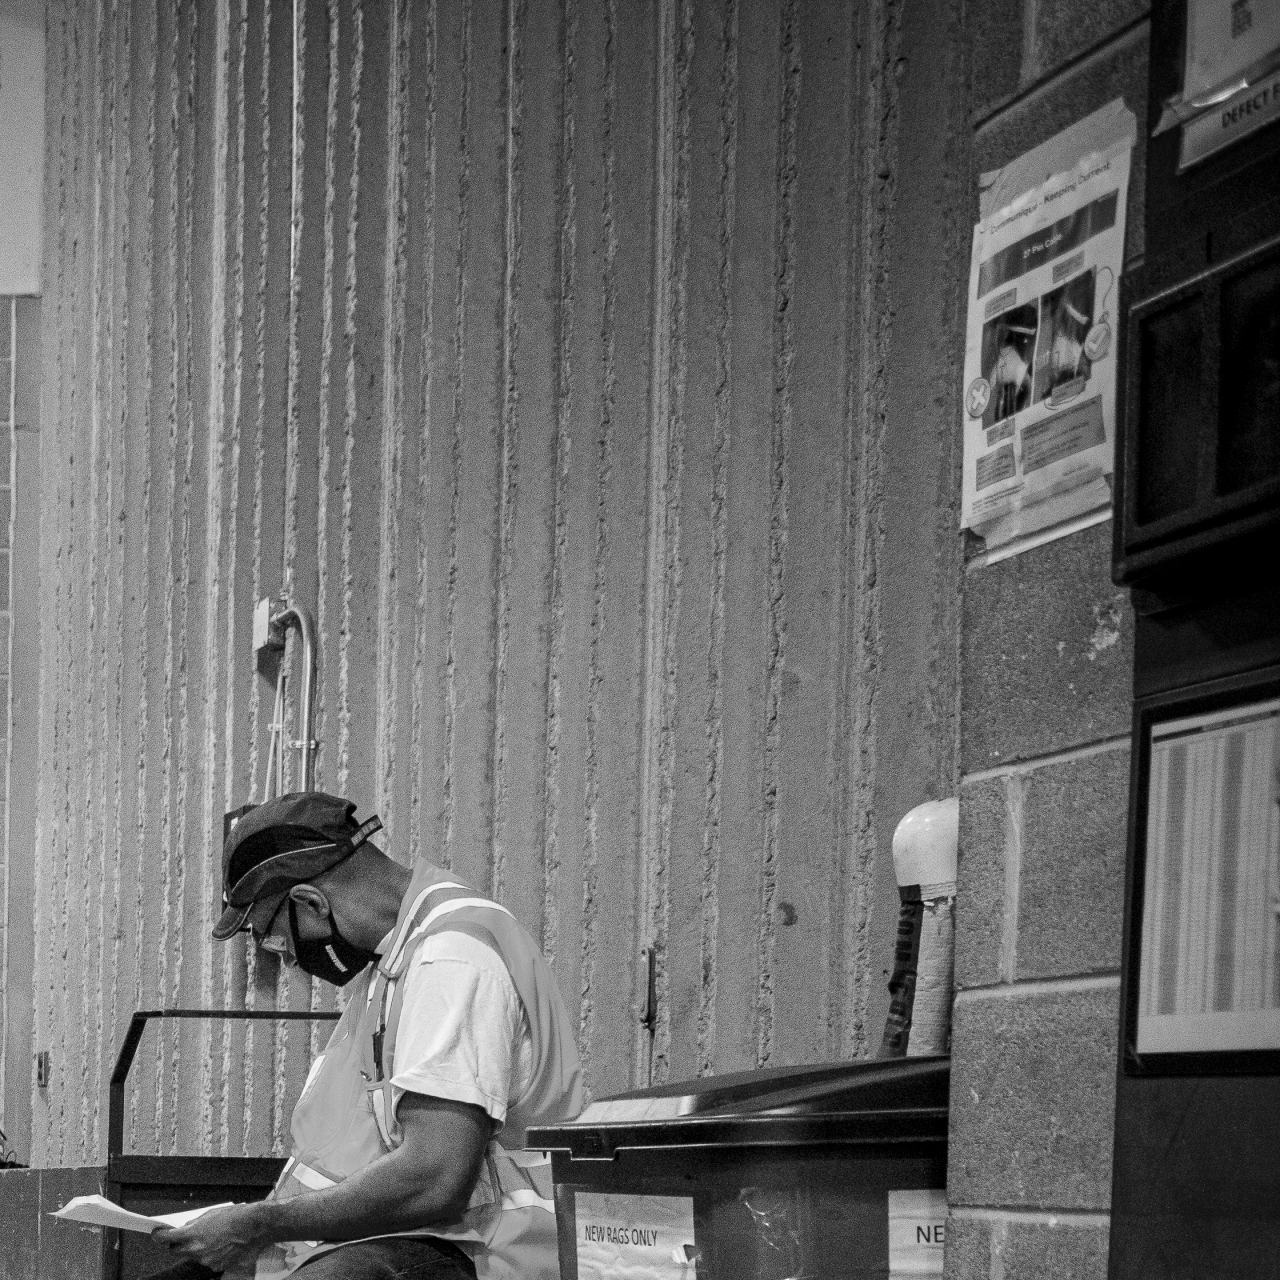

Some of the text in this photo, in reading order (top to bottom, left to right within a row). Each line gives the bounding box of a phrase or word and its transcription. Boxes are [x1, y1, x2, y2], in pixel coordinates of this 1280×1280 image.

[1222, 88, 1270, 128] DEFECT
[585, 1225, 658, 1247] NEW RAGS ONLY
